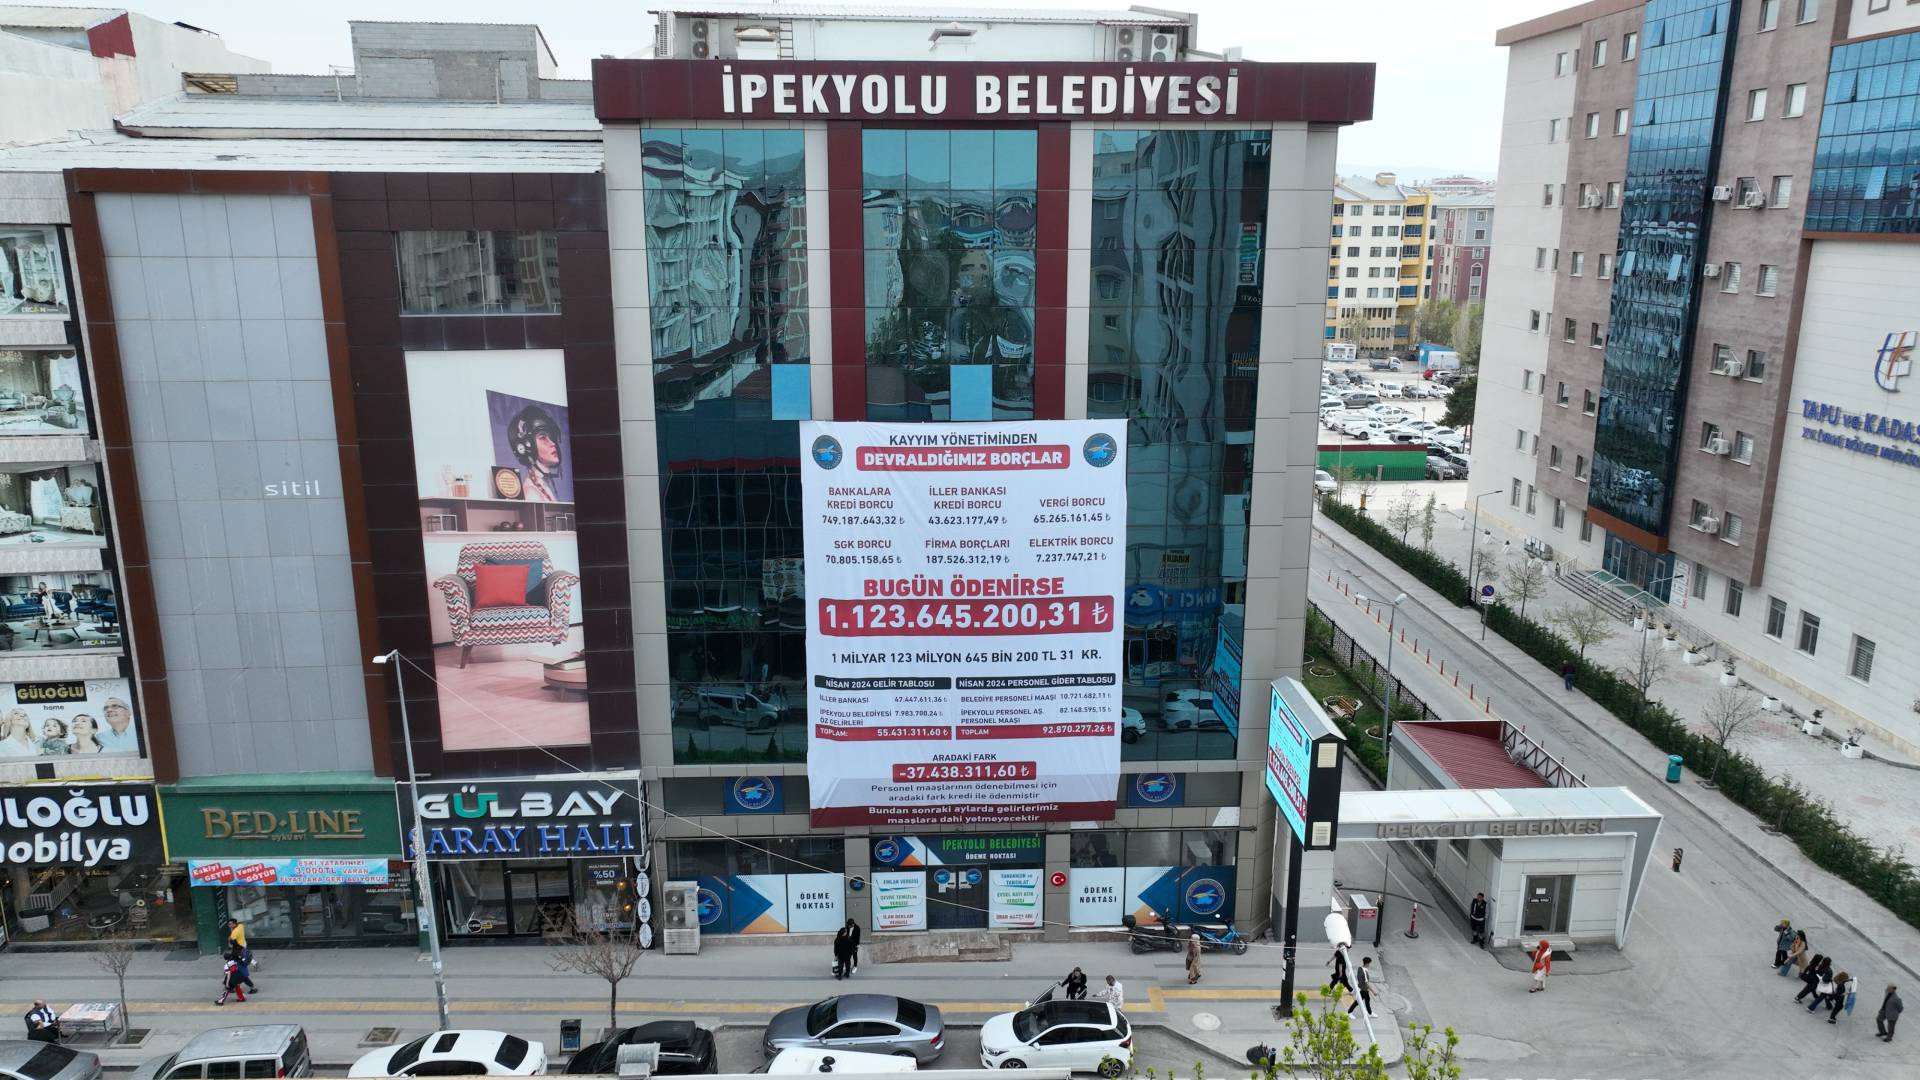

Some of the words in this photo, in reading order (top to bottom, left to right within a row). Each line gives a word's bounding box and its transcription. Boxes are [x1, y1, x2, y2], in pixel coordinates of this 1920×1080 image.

[721, 65, 947, 115] İPEKYOLU
[976, 67, 1239, 116] BELEDİYESİ
[1802, 399, 1840, 426] TAPU
[889, 433, 941, 446] KAYYIM
[943, 432, 1038, 446] YÖNETİMİNDEN
[864, 448, 986, 466] DEVRALDIĞIMIZ
[990, 451, 1063, 467] BORÇLAR
[264, 480, 320, 496] sitil
[828, 487, 892, 496] BANKALARA
[929, 485, 958, 496] İLLER
[960, 486, 1007, 496] BANKASI
[827, 499, 857, 510] KREDİ
[859, 500, 894, 510] BORCU
[933, 499, 965, 510] KREDİ
[967, 500, 1002, 509] BORCU
[1039, 496, 1069, 508] VERGİ
[1071, 497, 1105, 507] BORCU
[822, 514, 897, 526] 749.187.643,32
[928, 515, 999, 525] 43.623.177,49
[834, 539, 855, 549] SGK
[857, 539, 892, 549] BORCU
[925, 538, 957, 549] FİRMA
[959, 539, 1010, 550] BORÇLARI
[1029, 536, 1078, 548] ELEKTRİK
[1080, 536, 1114, 546] BORCU
[926, 555, 1002, 564] 187.526.312,19
[863, 575, 944, 597] BUGÜN
[950, 574, 1065, 597] ÖDENİRSE
[825, 602, 1081, 630] 1.123.645.200,31
[831, 653, 837, 664] 1
[841, 650, 887, 664] MİLYAR
[890, 652, 913, 664] 123
[915, 649, 962, 664] MİLYON
[965, 651, 988, 663] 645
[991, 649, 1013, 663] BİN
[1016, 651, 1039, 662] 200
[1041, 650, 1057, 662] TL
[1060, 649, 1075, 661] 31
[1081, 649, 1102, 661] KR.
[825, 678, 850, 689] NİSAN
[851, 680, 871, 689] 2024
[872, 678, 897, 688] GELİR
[897, 680, 935, 688] TABLOSU
[959, 678, 985, 688] NİSAN
[986, 679, 1006, 688] 2024
[1007, 679, 1050, 687] PERSONEL
[1051, 677, 1076, 686] GİDER
[1076, 676, 1114, 685] TABLOSU
[16, 683, 85, 700] GÜLOĞLU
[852, 709, 892, 718] BELEDİYESİ
[960, 708, 995, 716] İPEKYOLU
[995, 708, 1032, 716] PERSONEL
[960, 717, 997, 725] PERSONEL
[877, 728, 941, 738] 55.431.311,60
[932, 753, 972, 762] ARADAKİ
[973, 753, 997, 761] FARK
[899, 765, 1016, 779] -37.438.311,60
[871, 784, 914, 793] Personel
[916, 783, 973, 792] maaşlarının
[975, 782, 1038, 791] ödenebilmesi
[1040, 782, 1057, 790] için
[889, 793, 924, 801] aradaki
[926, 792, 947, 801] fark
[948, 792, 974, 801] kredi
[975, 792, 987, 800] ile
[989, 791, 1041, 800] ödenmiştir
[418, 785, 624, 819] GÜLBAY
[868, 806, 909, 815] Bundan
[911, 805, 951, 814] sonraki
[953, 805, 995, 814] aylarda
[996, 804, 1060, 813] gelirlerimiz
[887, 816, 938, 824] maaşlara
[939, 815, 963, 823] dahi
[964, 814, 1041, 823] yetmeyecektir
[537, 823, 635, 853] HALI
[989, 837, 1041, 850] BELEDİYESİ
[0, 831, 131, 867] obilya
[204, 869, 232, 883] GETİR
[246, 868, 276, 884] GÖTÜR
[593, 870, 615, 879] %50
[1083, 885, 1114, 895] ÖDEME
[799, 891, 831, 901] ÖDEME
[1079, 896, 1117, 904] NOKTASI
[796, 902, 835, 910] NOKTASI
